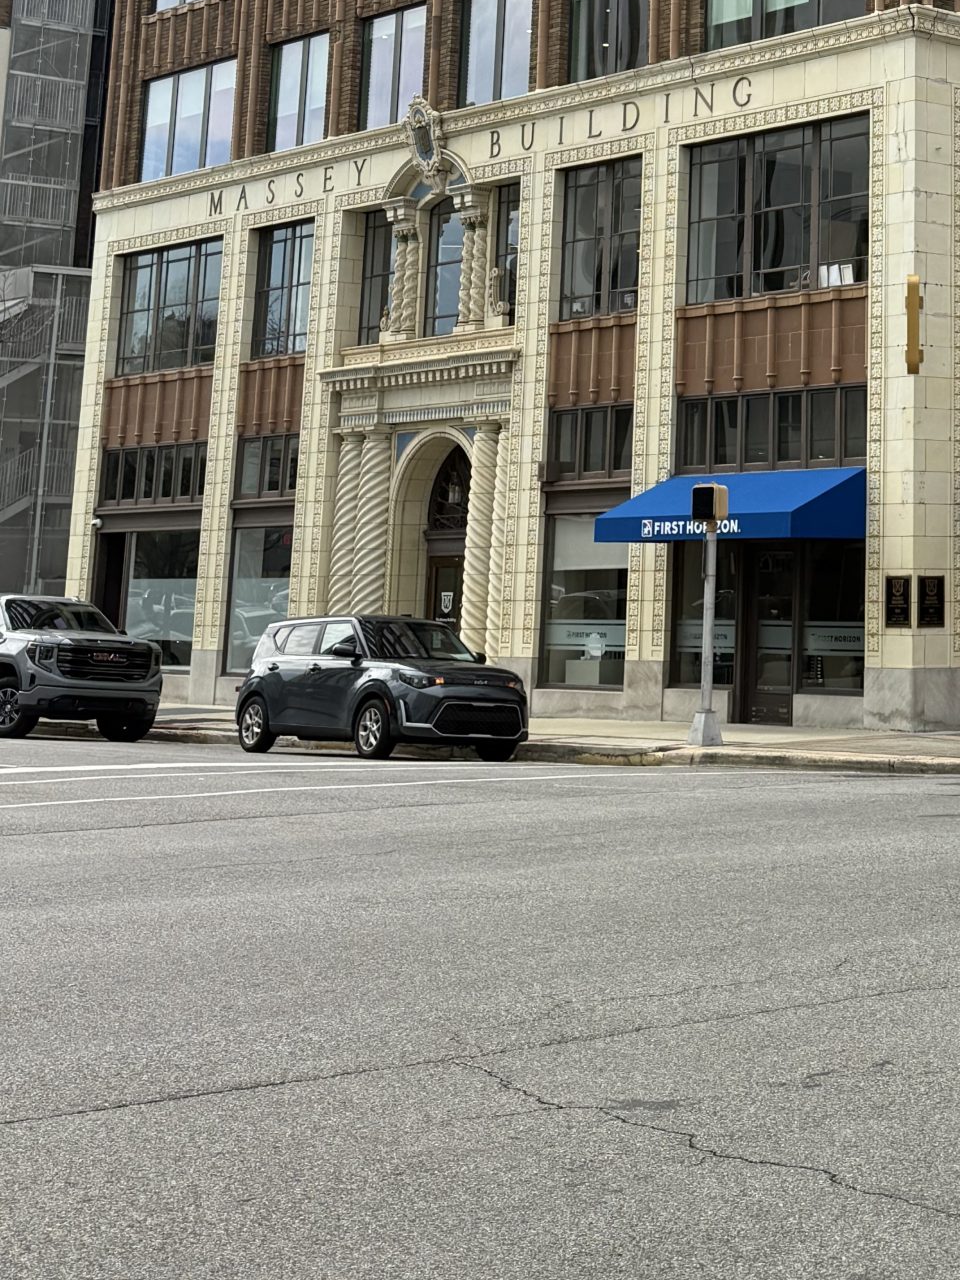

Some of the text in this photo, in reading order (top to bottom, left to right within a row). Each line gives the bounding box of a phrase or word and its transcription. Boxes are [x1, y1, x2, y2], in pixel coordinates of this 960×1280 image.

[208, 76, 752, 217] MASSEY BUILDING
[654, 521, 685, 535] FIRST
